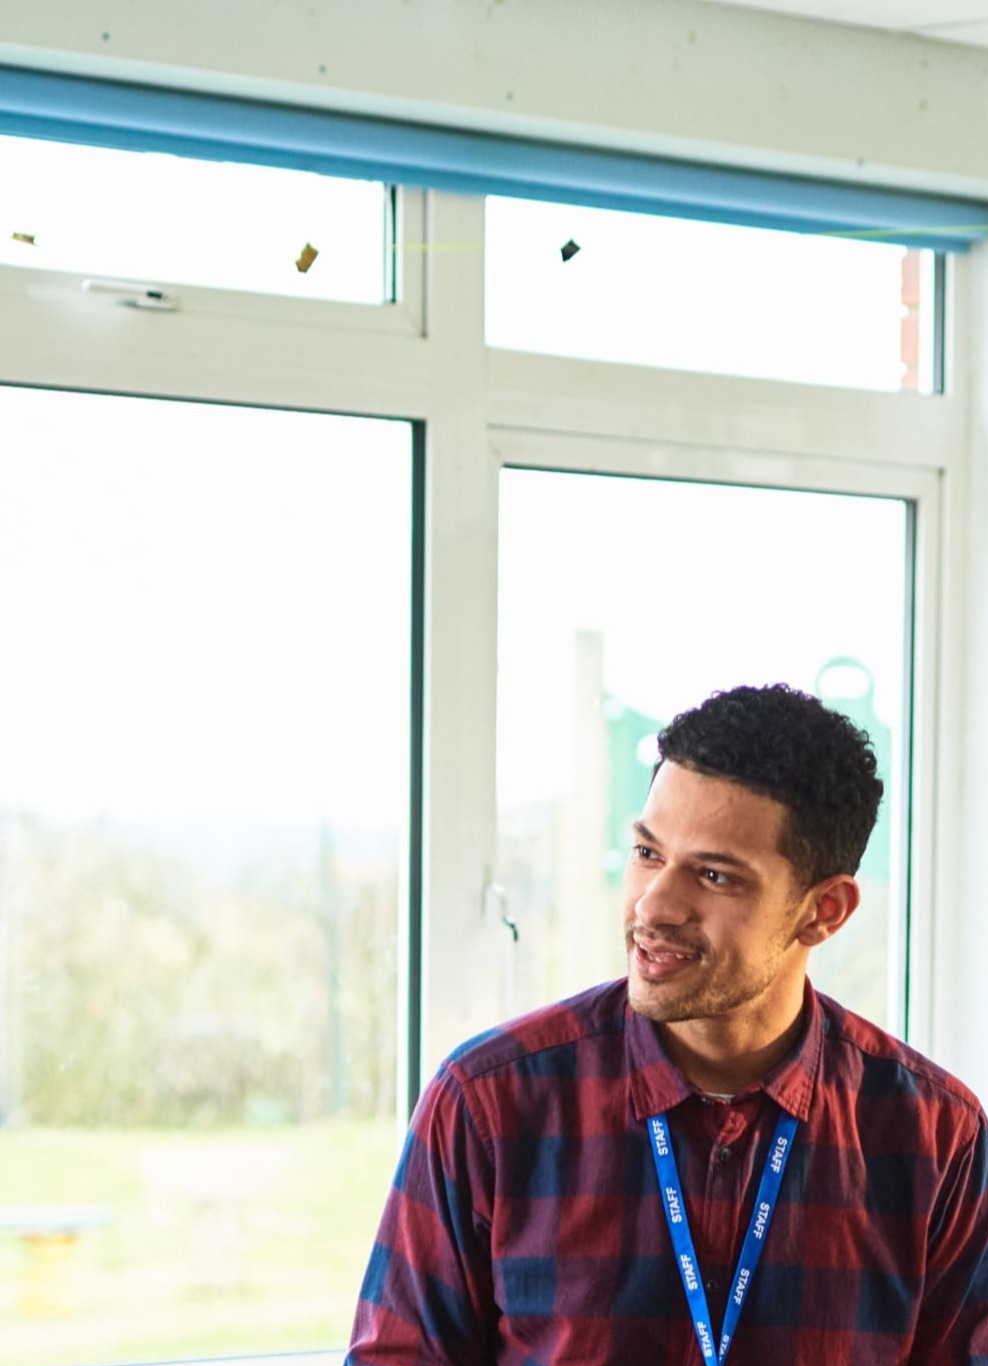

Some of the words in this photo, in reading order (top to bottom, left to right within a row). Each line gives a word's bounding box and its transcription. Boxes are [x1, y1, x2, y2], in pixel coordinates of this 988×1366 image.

[653, 1120, 668, 1156] STAFF
[771, 1136, 788, 1173] STAFF
[666, 1187, 682, 1223] STAFF
[753, 1202, 770, 1240] STAFF
[680, 1254, 697, 1290] STAFF
[734, 1267, 750, 1304] STAFF
[697, 1322, 713, 1356] STAFF
